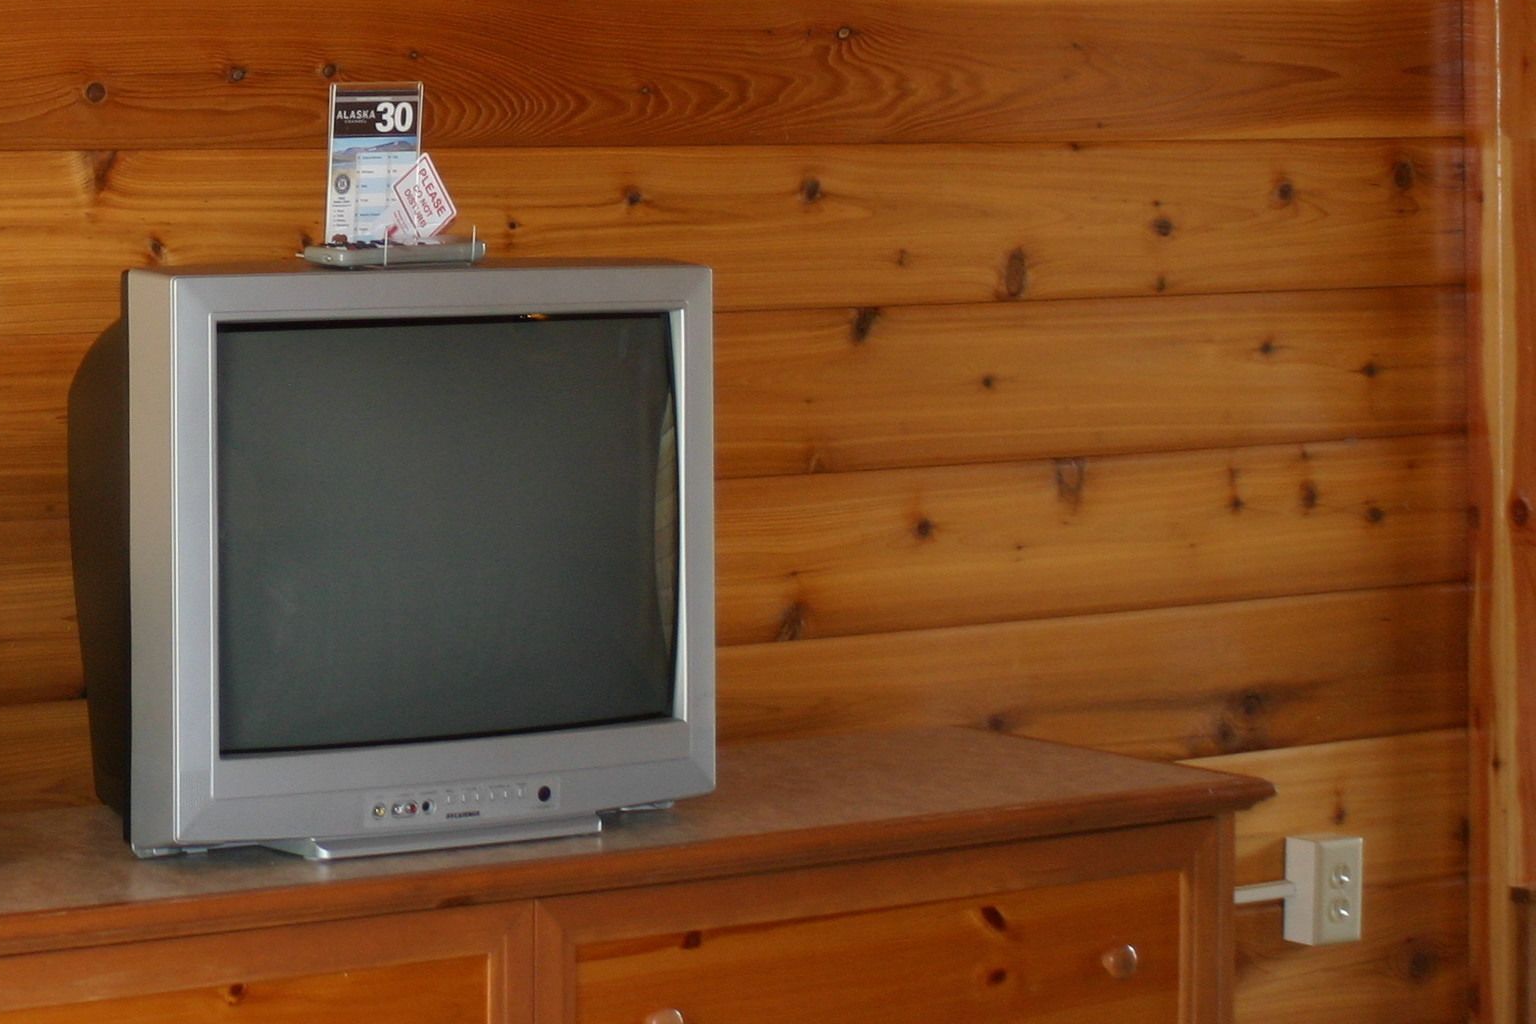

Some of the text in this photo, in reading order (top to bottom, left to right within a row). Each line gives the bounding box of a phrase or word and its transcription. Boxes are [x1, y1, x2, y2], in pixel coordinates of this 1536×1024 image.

[336, 102, 413, 132] ALASKA 30
[419, 168, 446, 217] PLEASE
[420, 198, 432, 216] NOT
